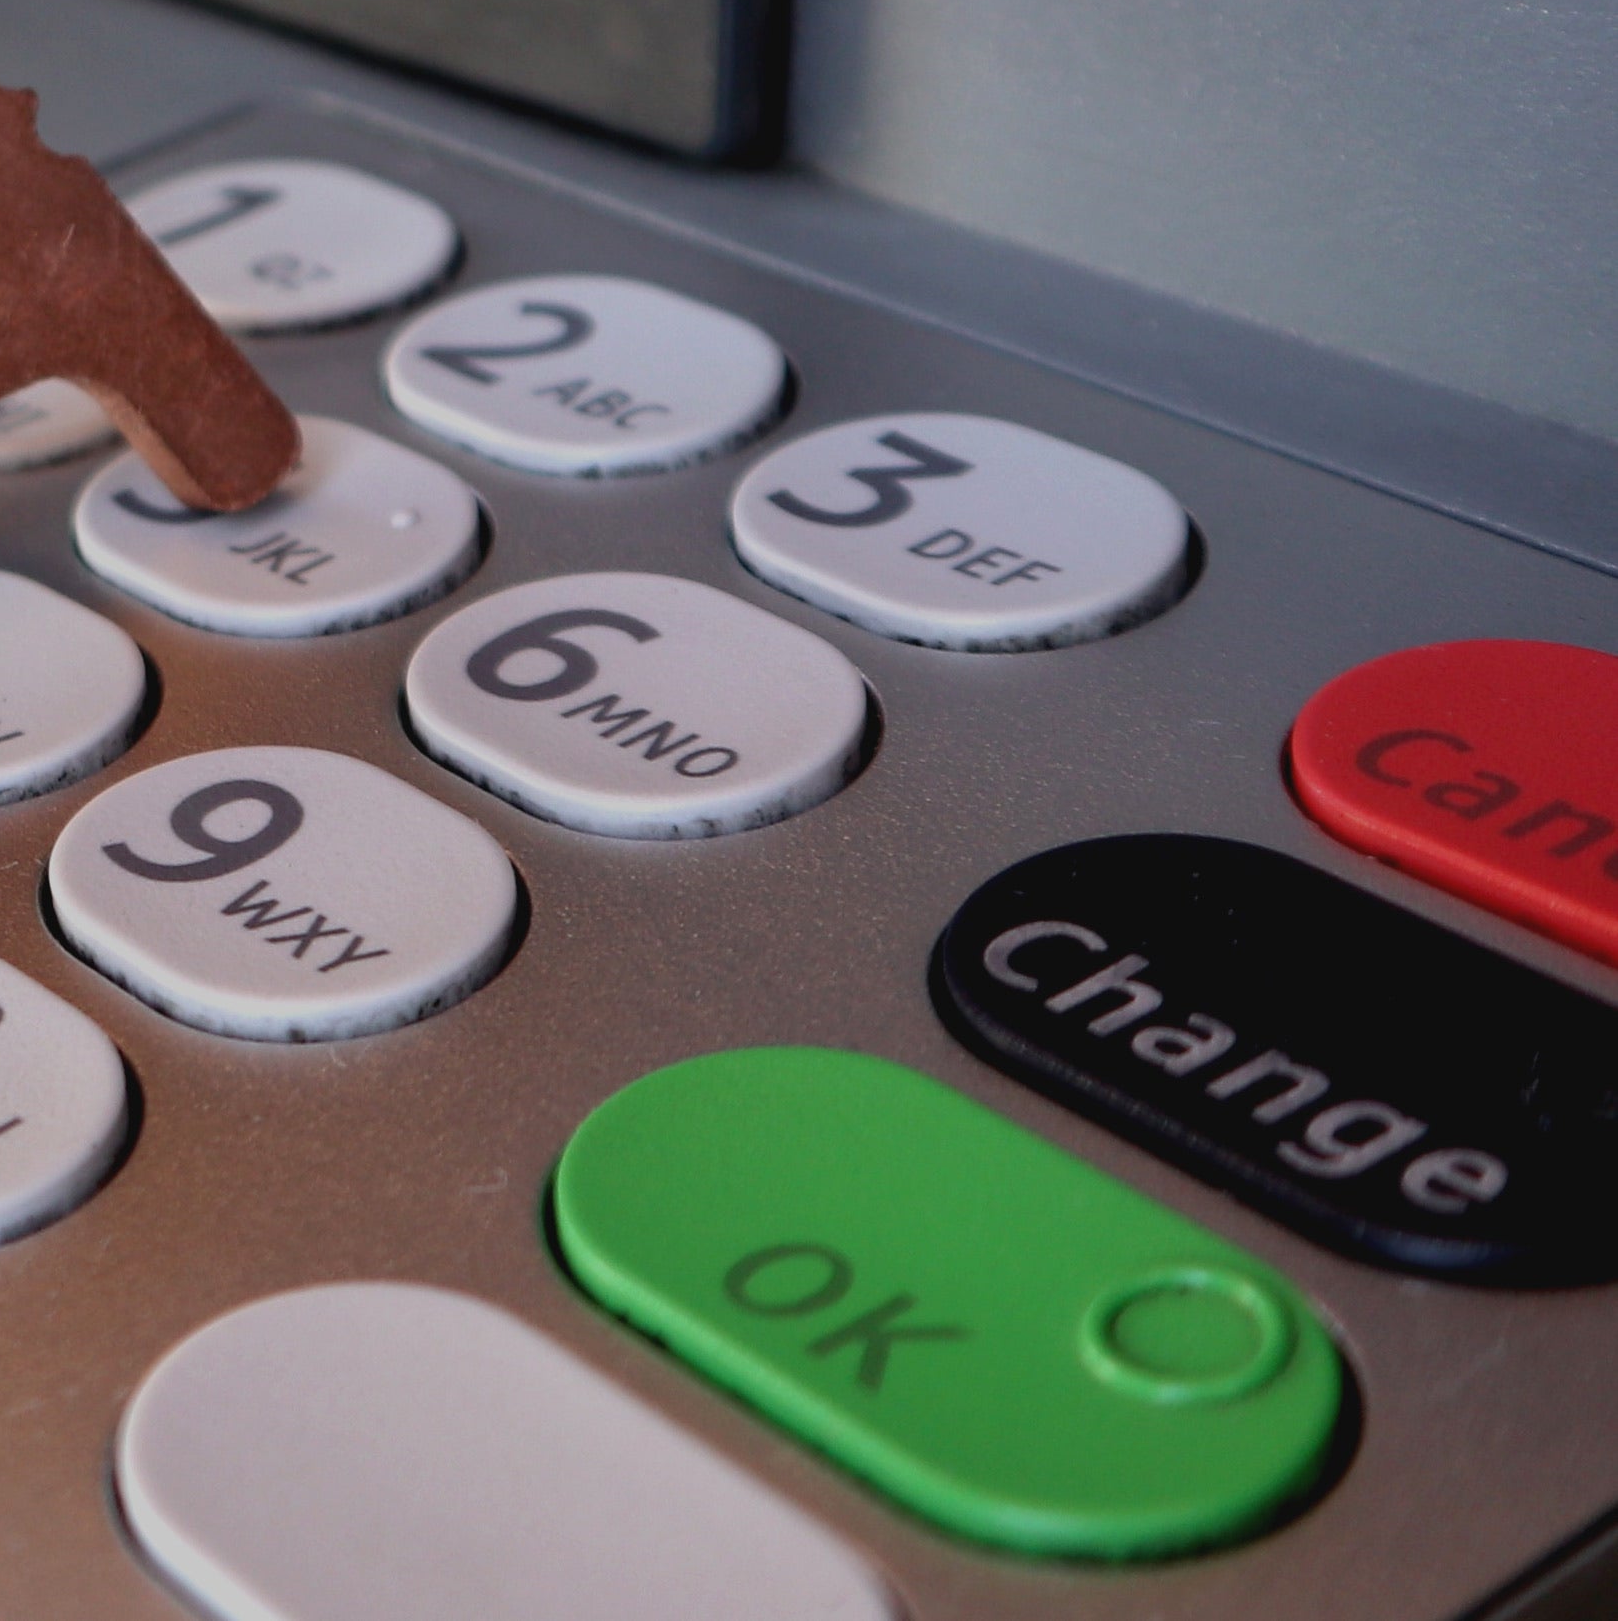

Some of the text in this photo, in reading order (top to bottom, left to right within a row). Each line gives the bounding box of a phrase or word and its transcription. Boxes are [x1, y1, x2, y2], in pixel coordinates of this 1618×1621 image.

[155, 184, 281, 247] 1
[419, 301, 676, 431] 2 ABC
[228, 533, 336, 585] JKL
[767, 430, 1063, 589] 3 DEF
[465, 608, 740, 779] 6 MNO
[101, 779, 391, 975] 9 WXY
[982, 918, 1509, 1215] Change
[721, 1241, 974, 1395] OK
